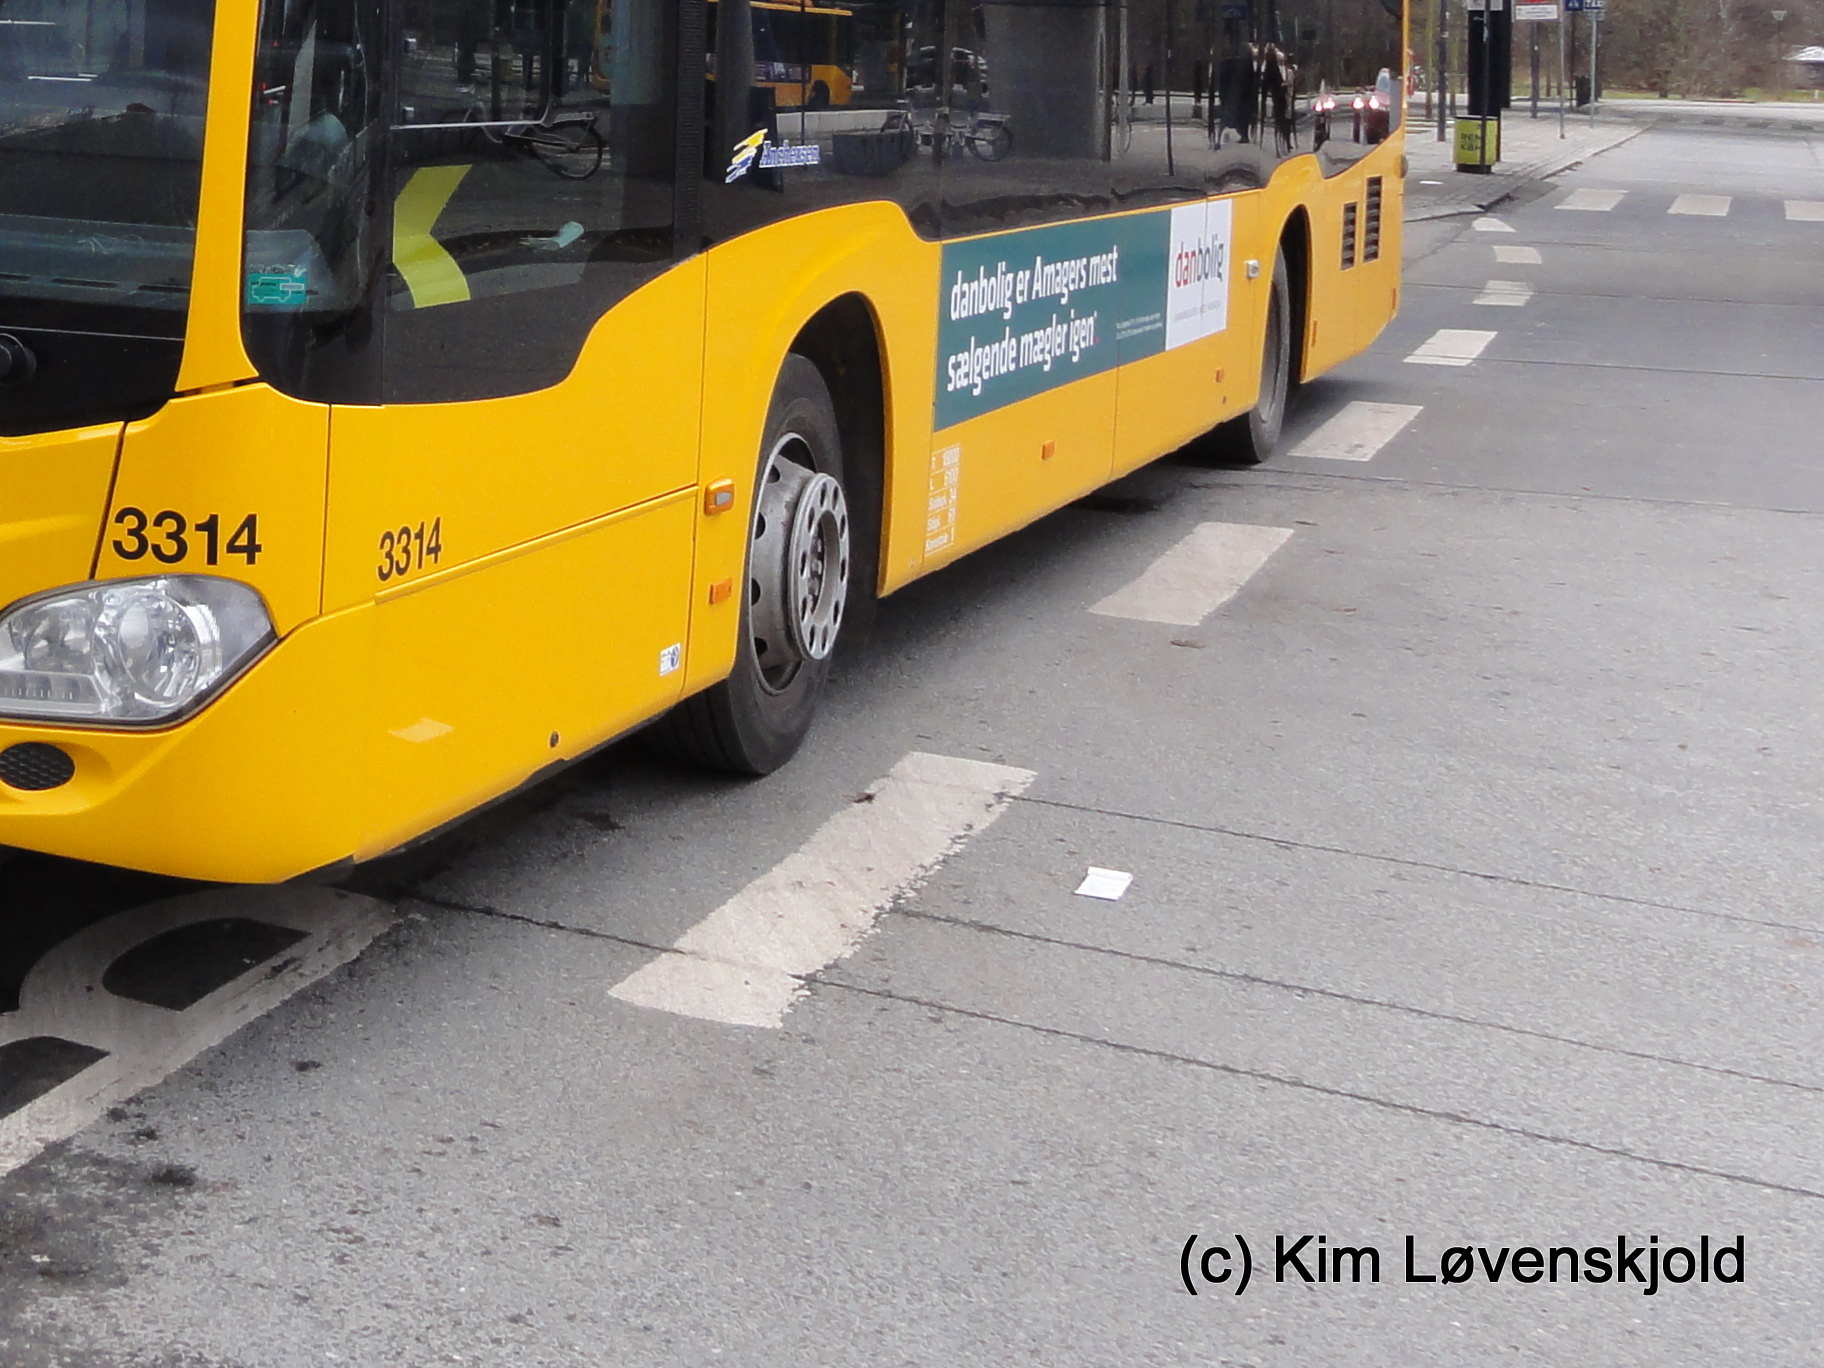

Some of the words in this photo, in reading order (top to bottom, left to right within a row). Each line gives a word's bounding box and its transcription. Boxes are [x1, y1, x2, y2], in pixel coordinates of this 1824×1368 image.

[950, 261, 1013, 322] danbolig
[1016, 271, 1030, 304] er
[1031, 254, 1087, 306] Amagers
[1088, 245, 1119, 286] mest
[1176, 233, 1224, 289] danbolig
[946, 326, 1016, 396] sælgende
[1019, 312, 1067, 372] mægler
[112, 506, 263, 566] 3314
[376, 516, 442, 582] 3314
